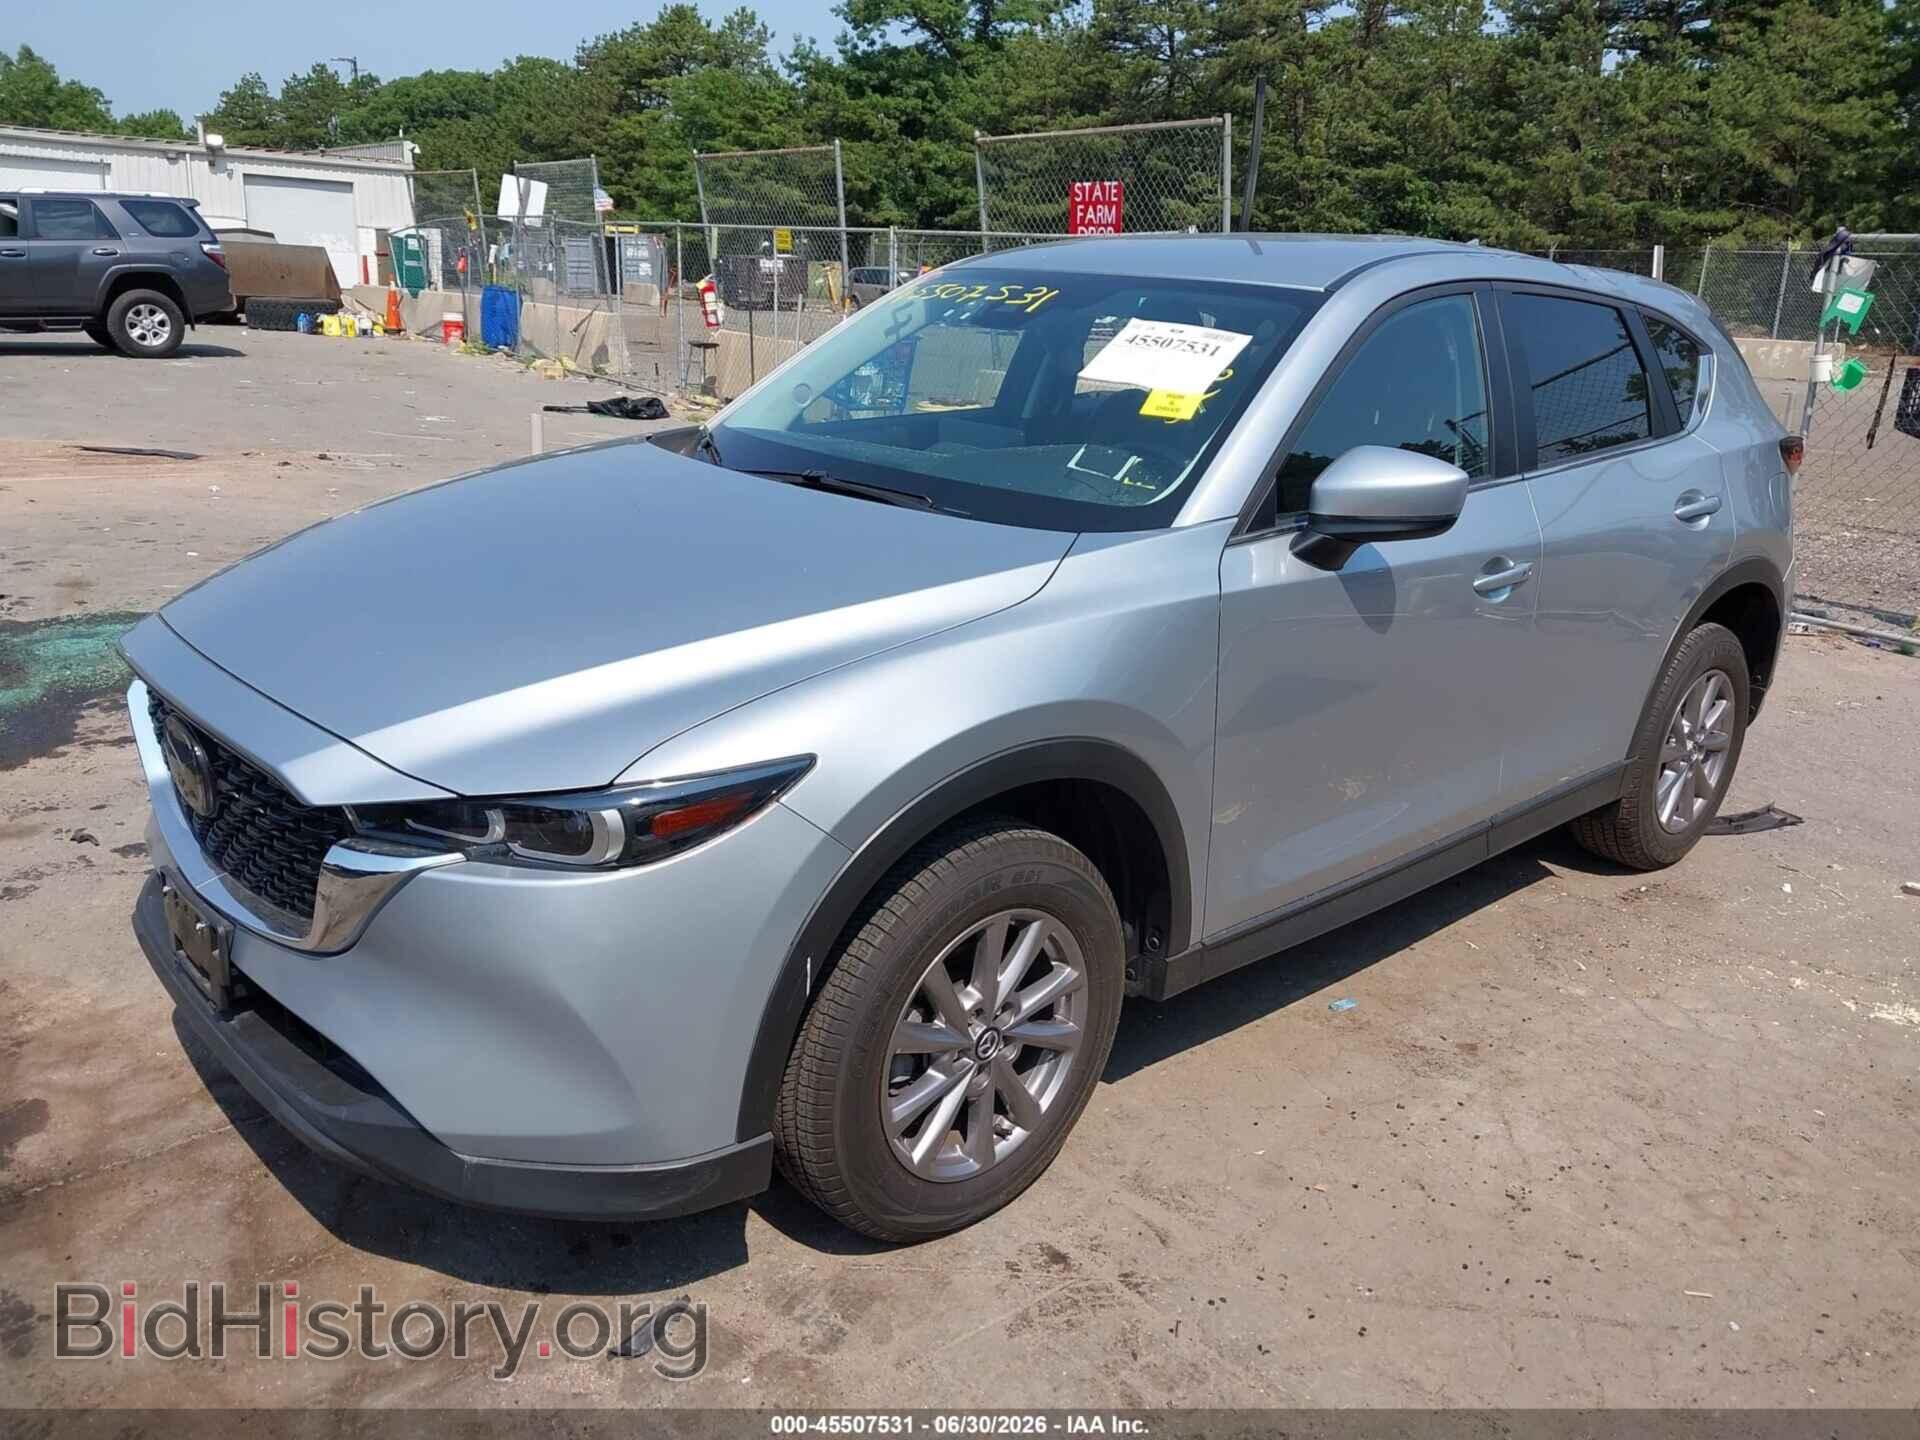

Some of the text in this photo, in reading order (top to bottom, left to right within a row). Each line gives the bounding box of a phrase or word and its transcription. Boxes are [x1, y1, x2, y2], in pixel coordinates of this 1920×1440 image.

[1074, 181, 1118, 202] STATE
[1077, 205, 1116, 225] FARM
[1125, 334, 1221, 357] 45507531
